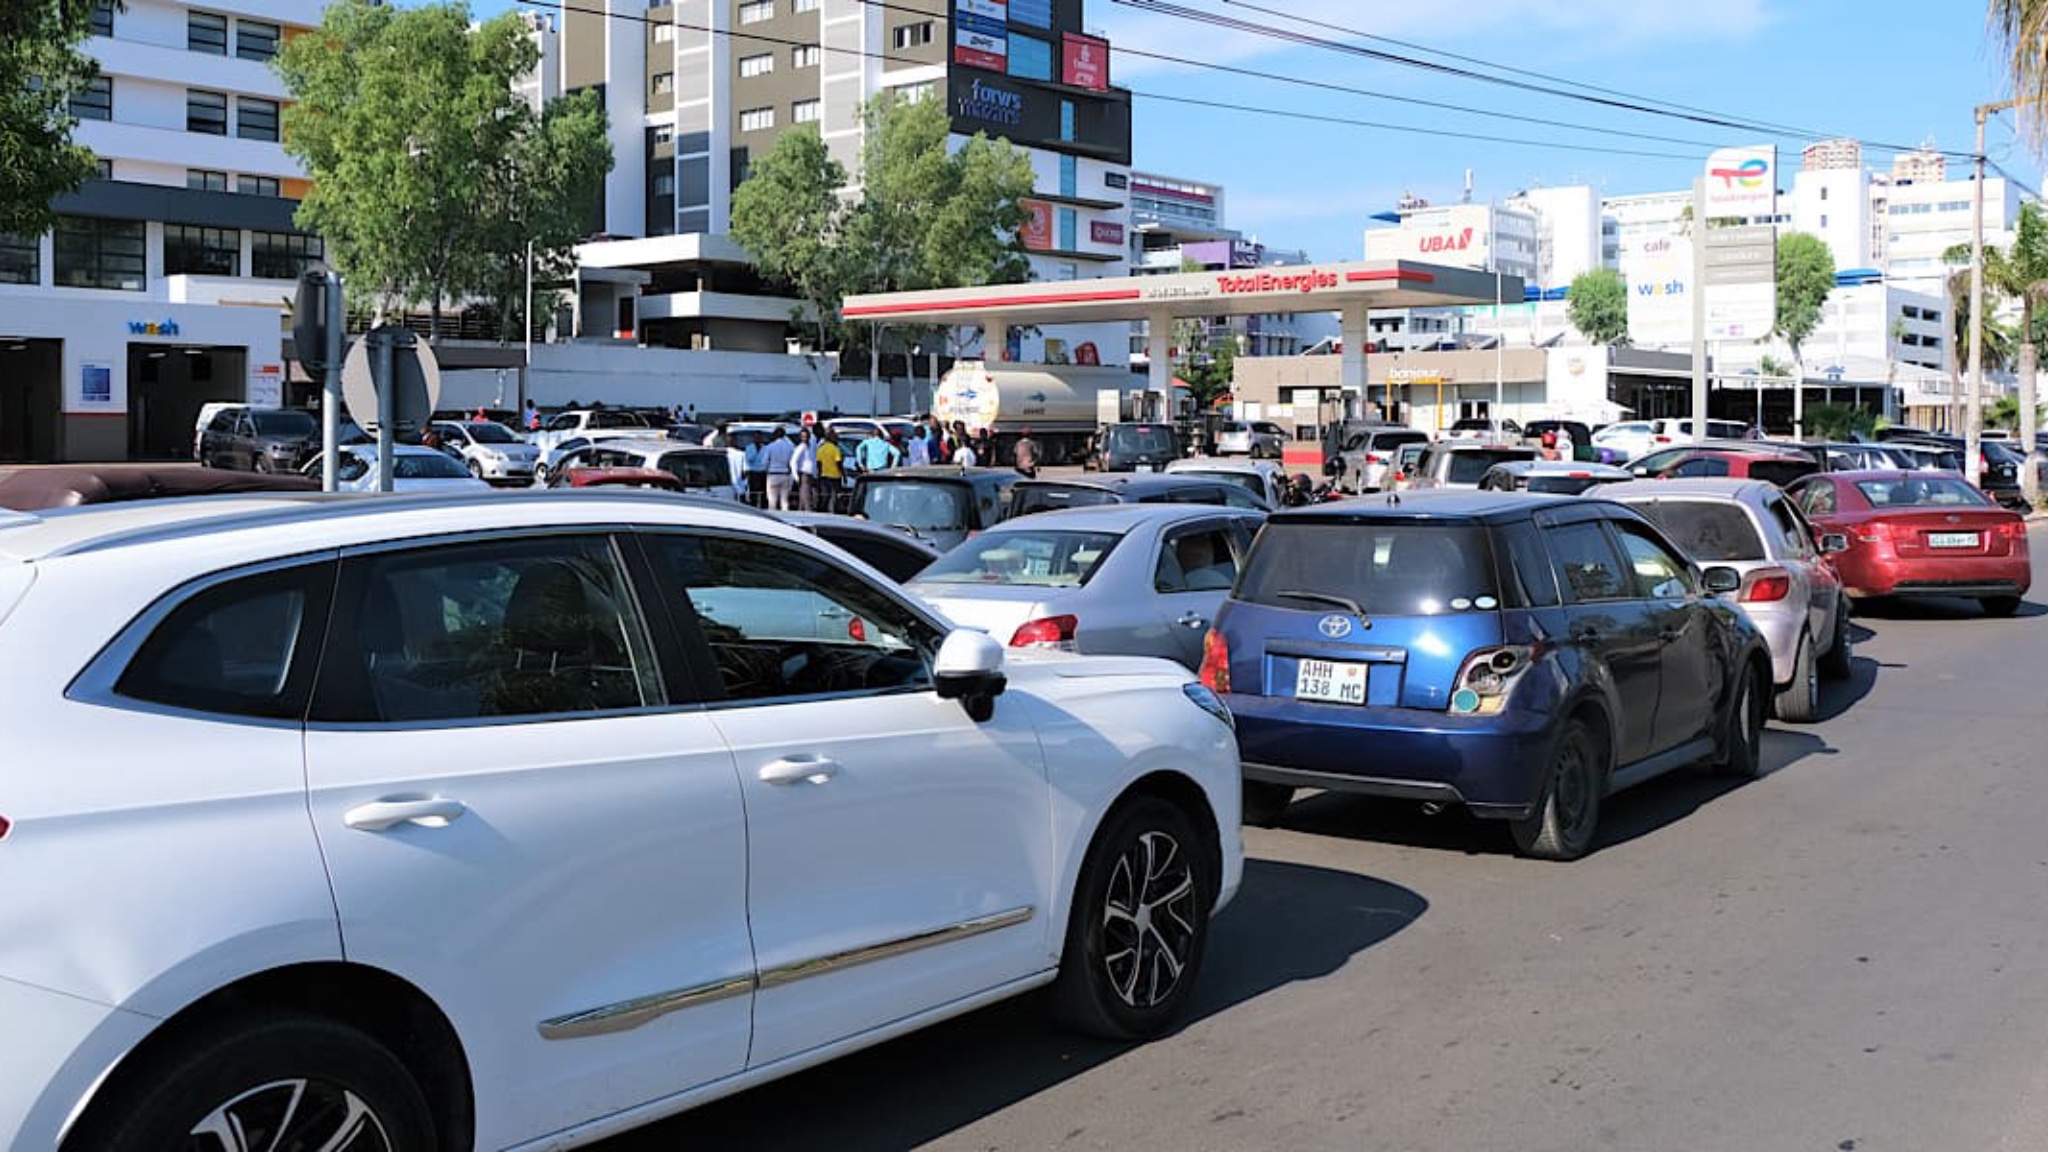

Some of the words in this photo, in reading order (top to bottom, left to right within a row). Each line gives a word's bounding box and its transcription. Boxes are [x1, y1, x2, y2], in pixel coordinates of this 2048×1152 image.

[1420, 235, 1456, 252] UBA
[1217, 270, 1338, 293] TotalEnergies
[1638, 279, 1684, 296] wash
[127, 318, 180, 336] wash
[1302, 661, 1333, 678] AHH
[1300, 678, 1331, 696] 138
[1340, 683, 1362, 700] MC
